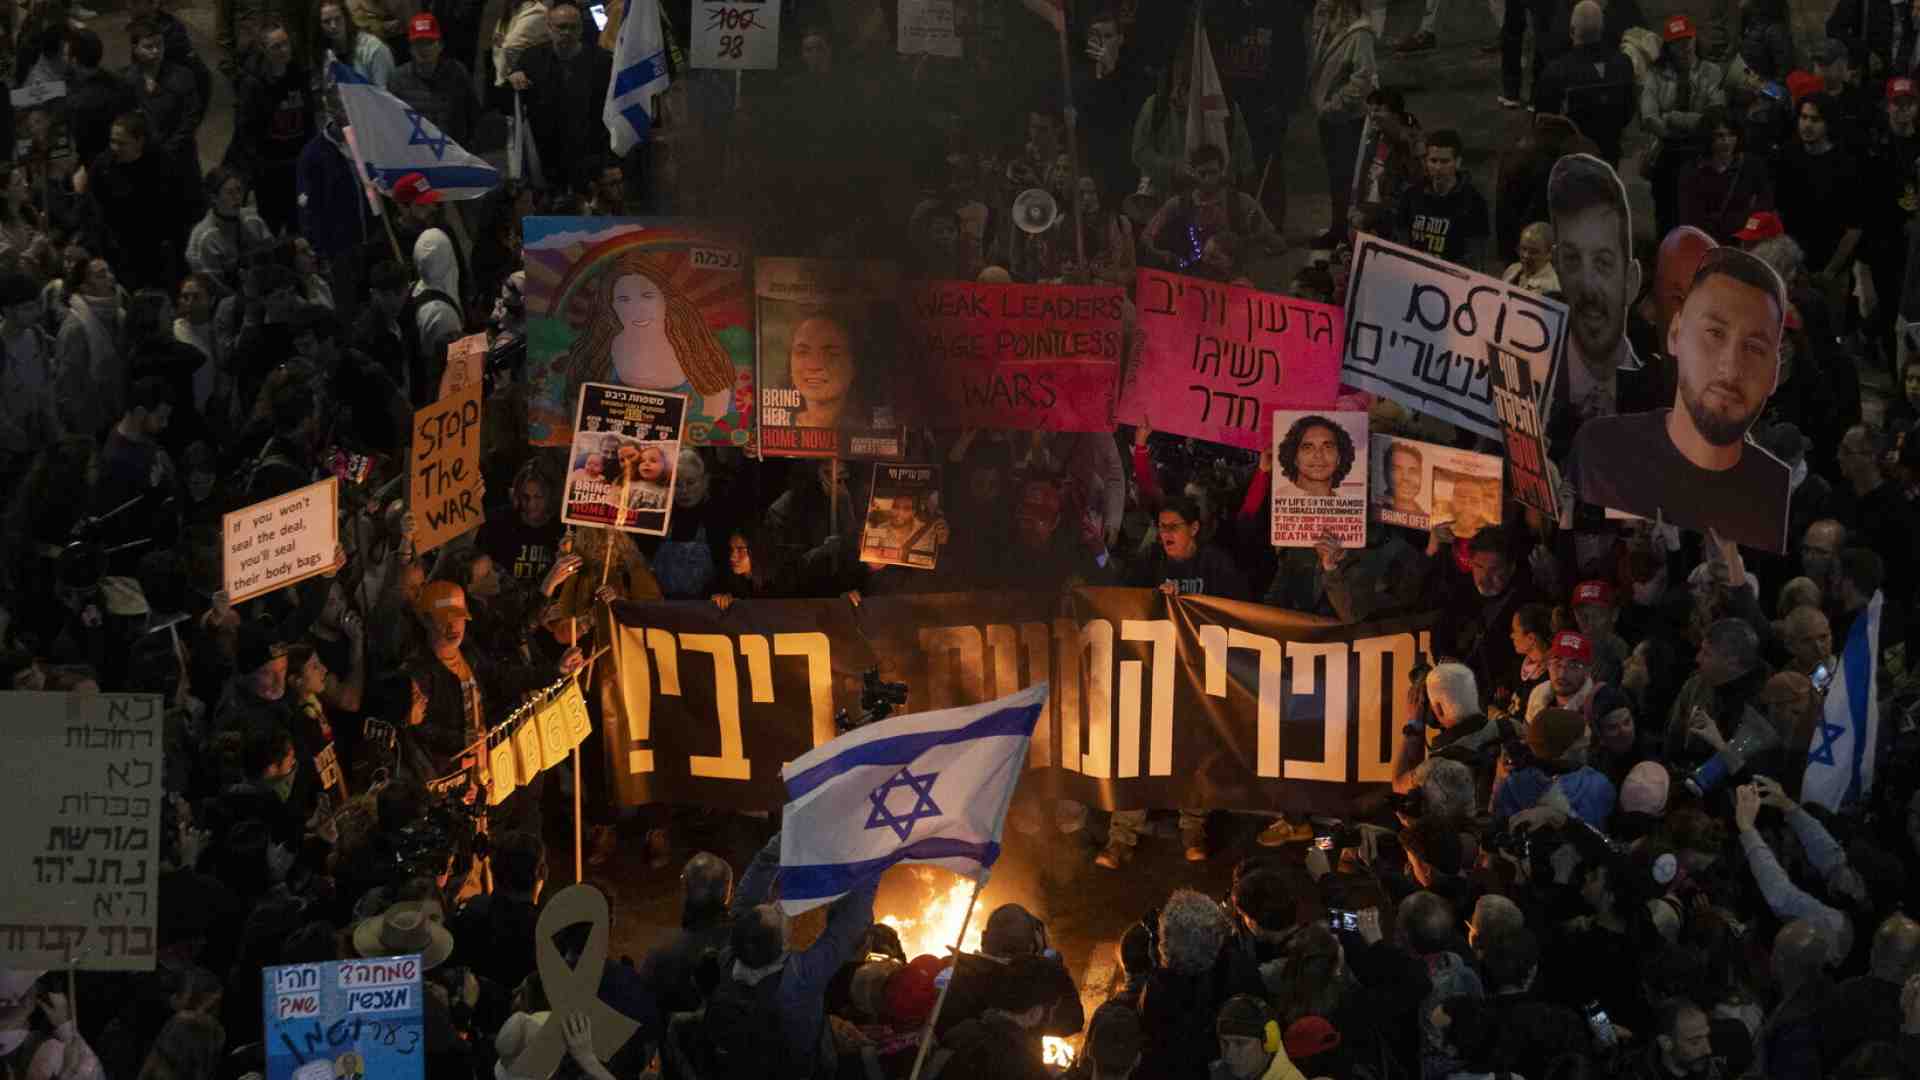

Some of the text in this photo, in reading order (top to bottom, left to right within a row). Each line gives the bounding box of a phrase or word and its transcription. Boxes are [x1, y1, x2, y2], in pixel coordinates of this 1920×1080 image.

[999, 292, 1123, 320] LEADERS
[996, 327, 1119, 358] POINTLESS
[762, 388, 801, 408] BRING
[961, 372, 1057, 408] WARS
[419, 399, 478, 460] STOP
[252, 512, 273, 528] you
[425, 488, 479, 531] WAR
[231, 535, 253, 554] seal
[257, 531, 275, 545] the
[274, 540, 296, 558] seal
[233, 552, 322, 591] their body bags
[108, 696, 153, 723] לא
[106, 758, 153, 788] לא
[32, 856, 147, 885] נתניהו
